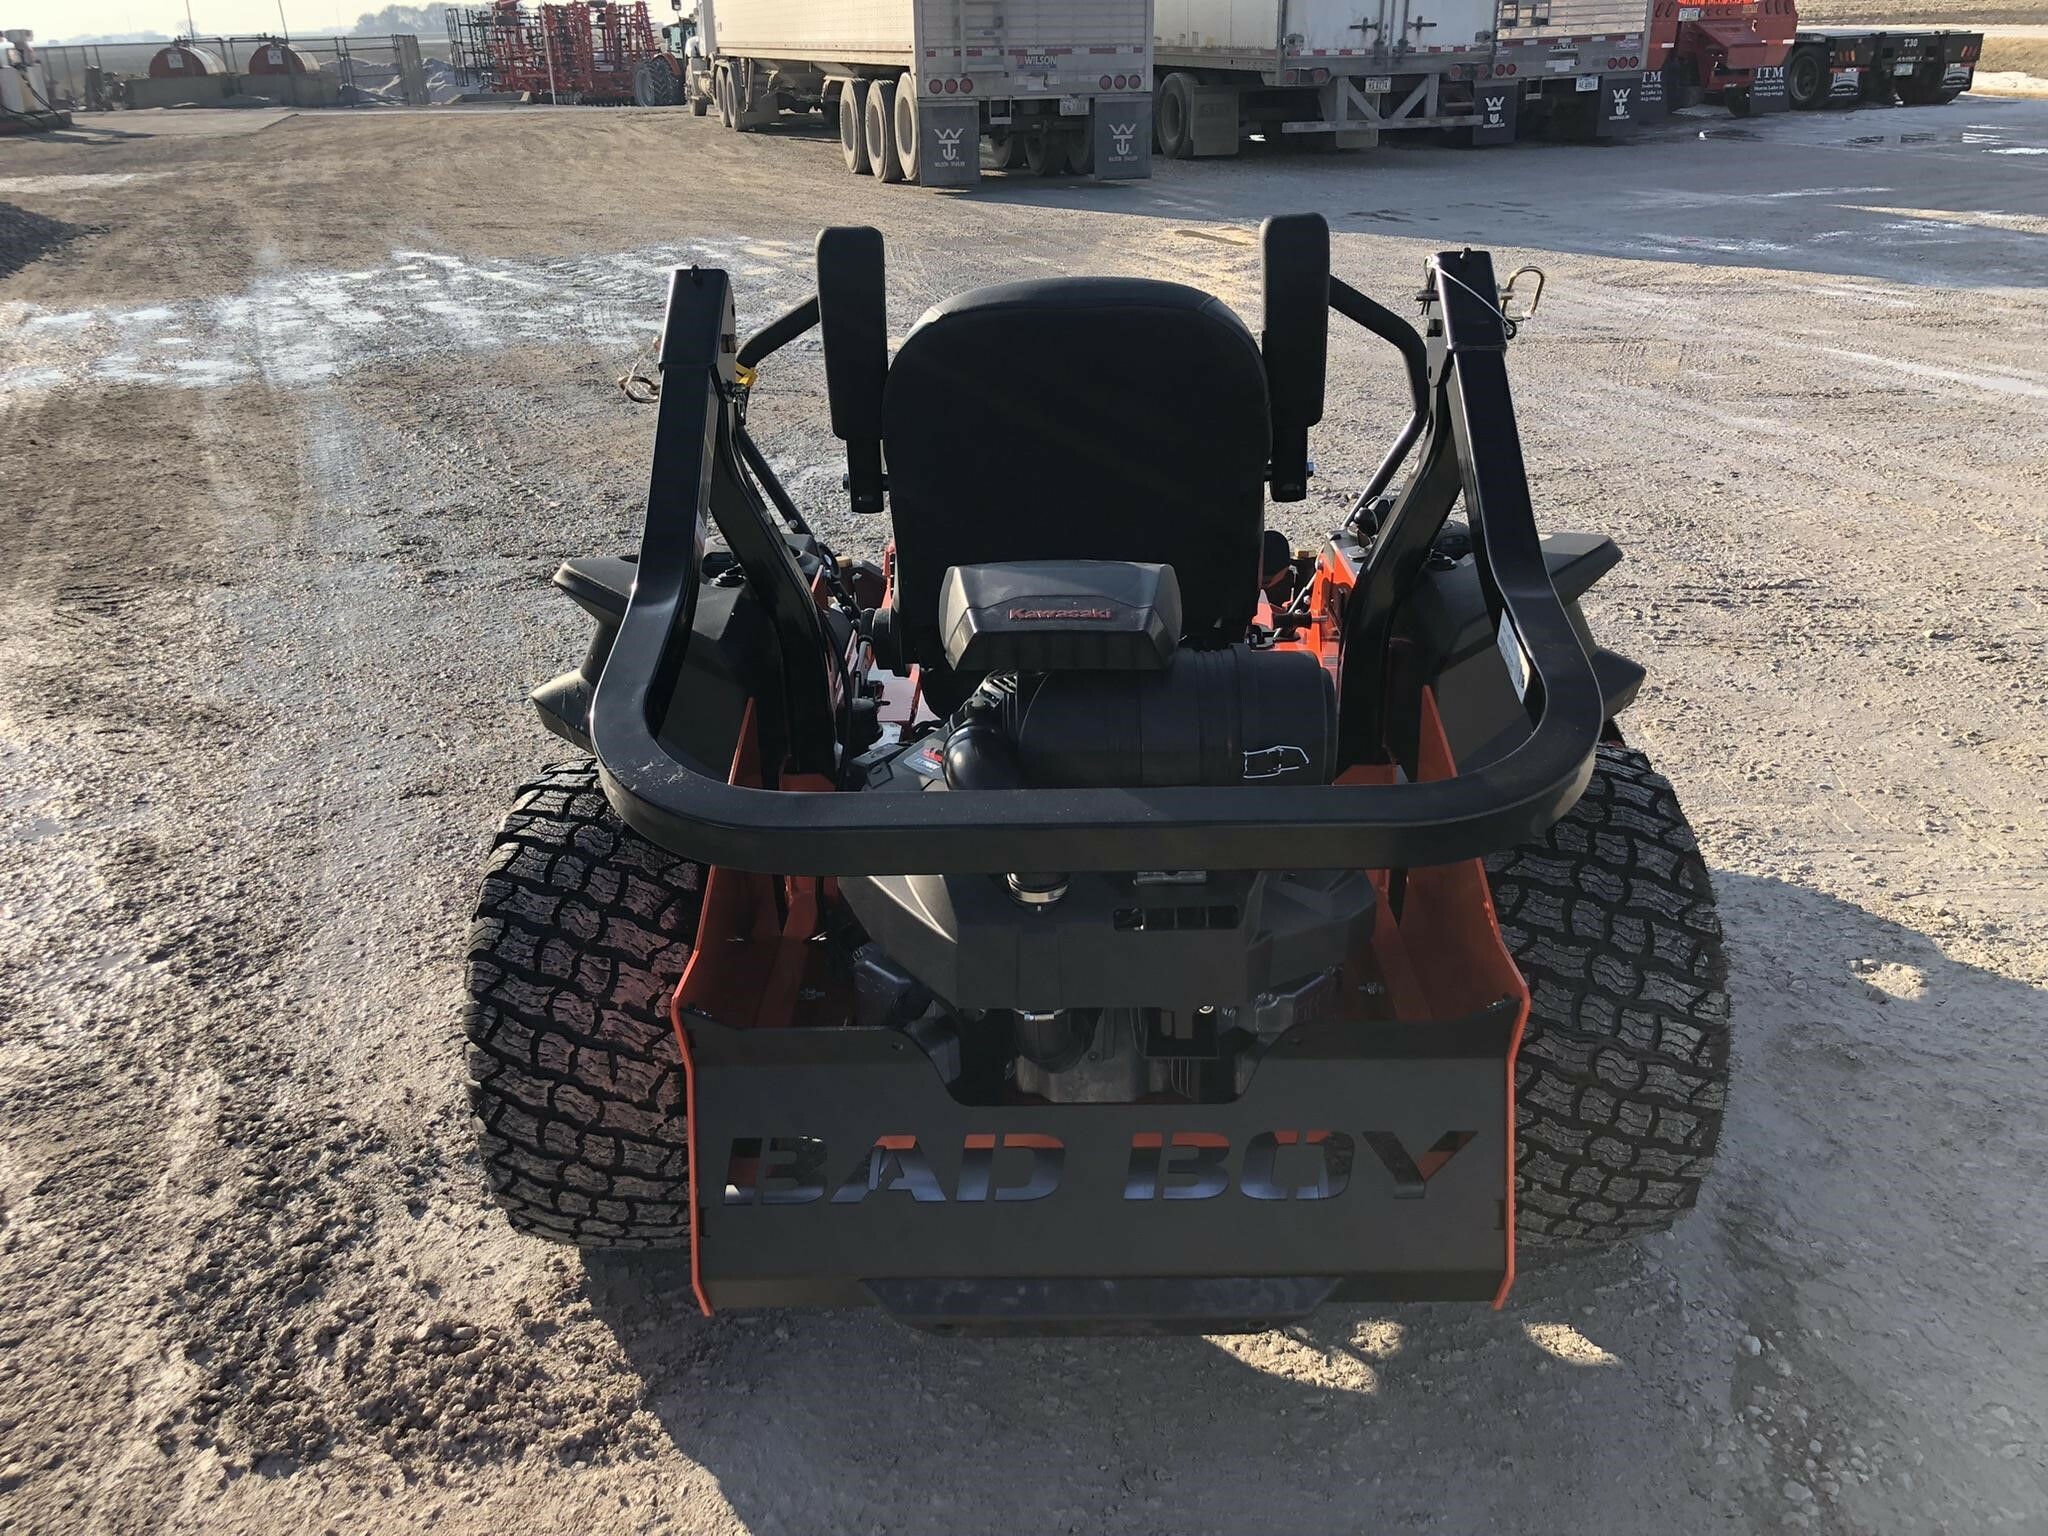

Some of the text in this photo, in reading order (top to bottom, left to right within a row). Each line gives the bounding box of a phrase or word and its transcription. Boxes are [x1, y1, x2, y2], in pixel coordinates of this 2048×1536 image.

[1903, 38, 1919, 48] T30
[1024, 55, 1057, 65] WILSON
[1641, 70, 1662, 83] TM
[1756, 66, 1785, 79] ITM
[1008, 608, 1112, 620] Kawasaki
[723, 1130, 1479, 1205] BAD BOY
